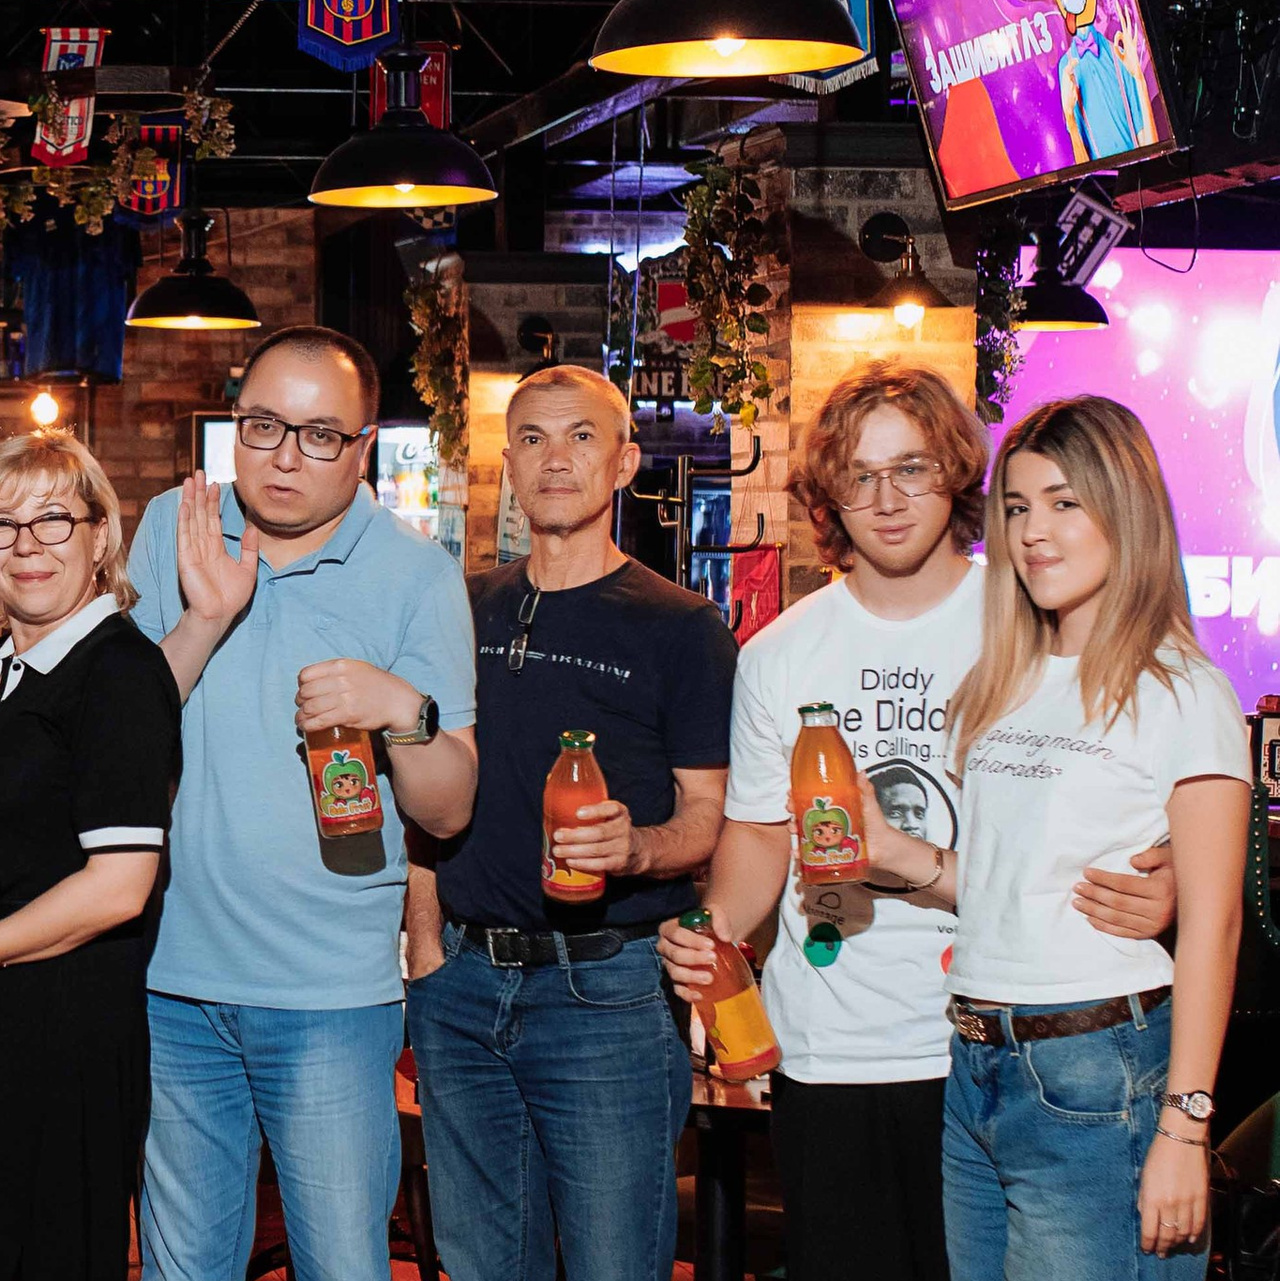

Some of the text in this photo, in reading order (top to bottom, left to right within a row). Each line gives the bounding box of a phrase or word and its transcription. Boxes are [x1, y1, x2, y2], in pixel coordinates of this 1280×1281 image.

[861, 666, 934, 695] Diddy
[876, 697, 951, 732] Didd
[853, 741, 869, 759] Is
[1051, 736, 1116, 760] main
